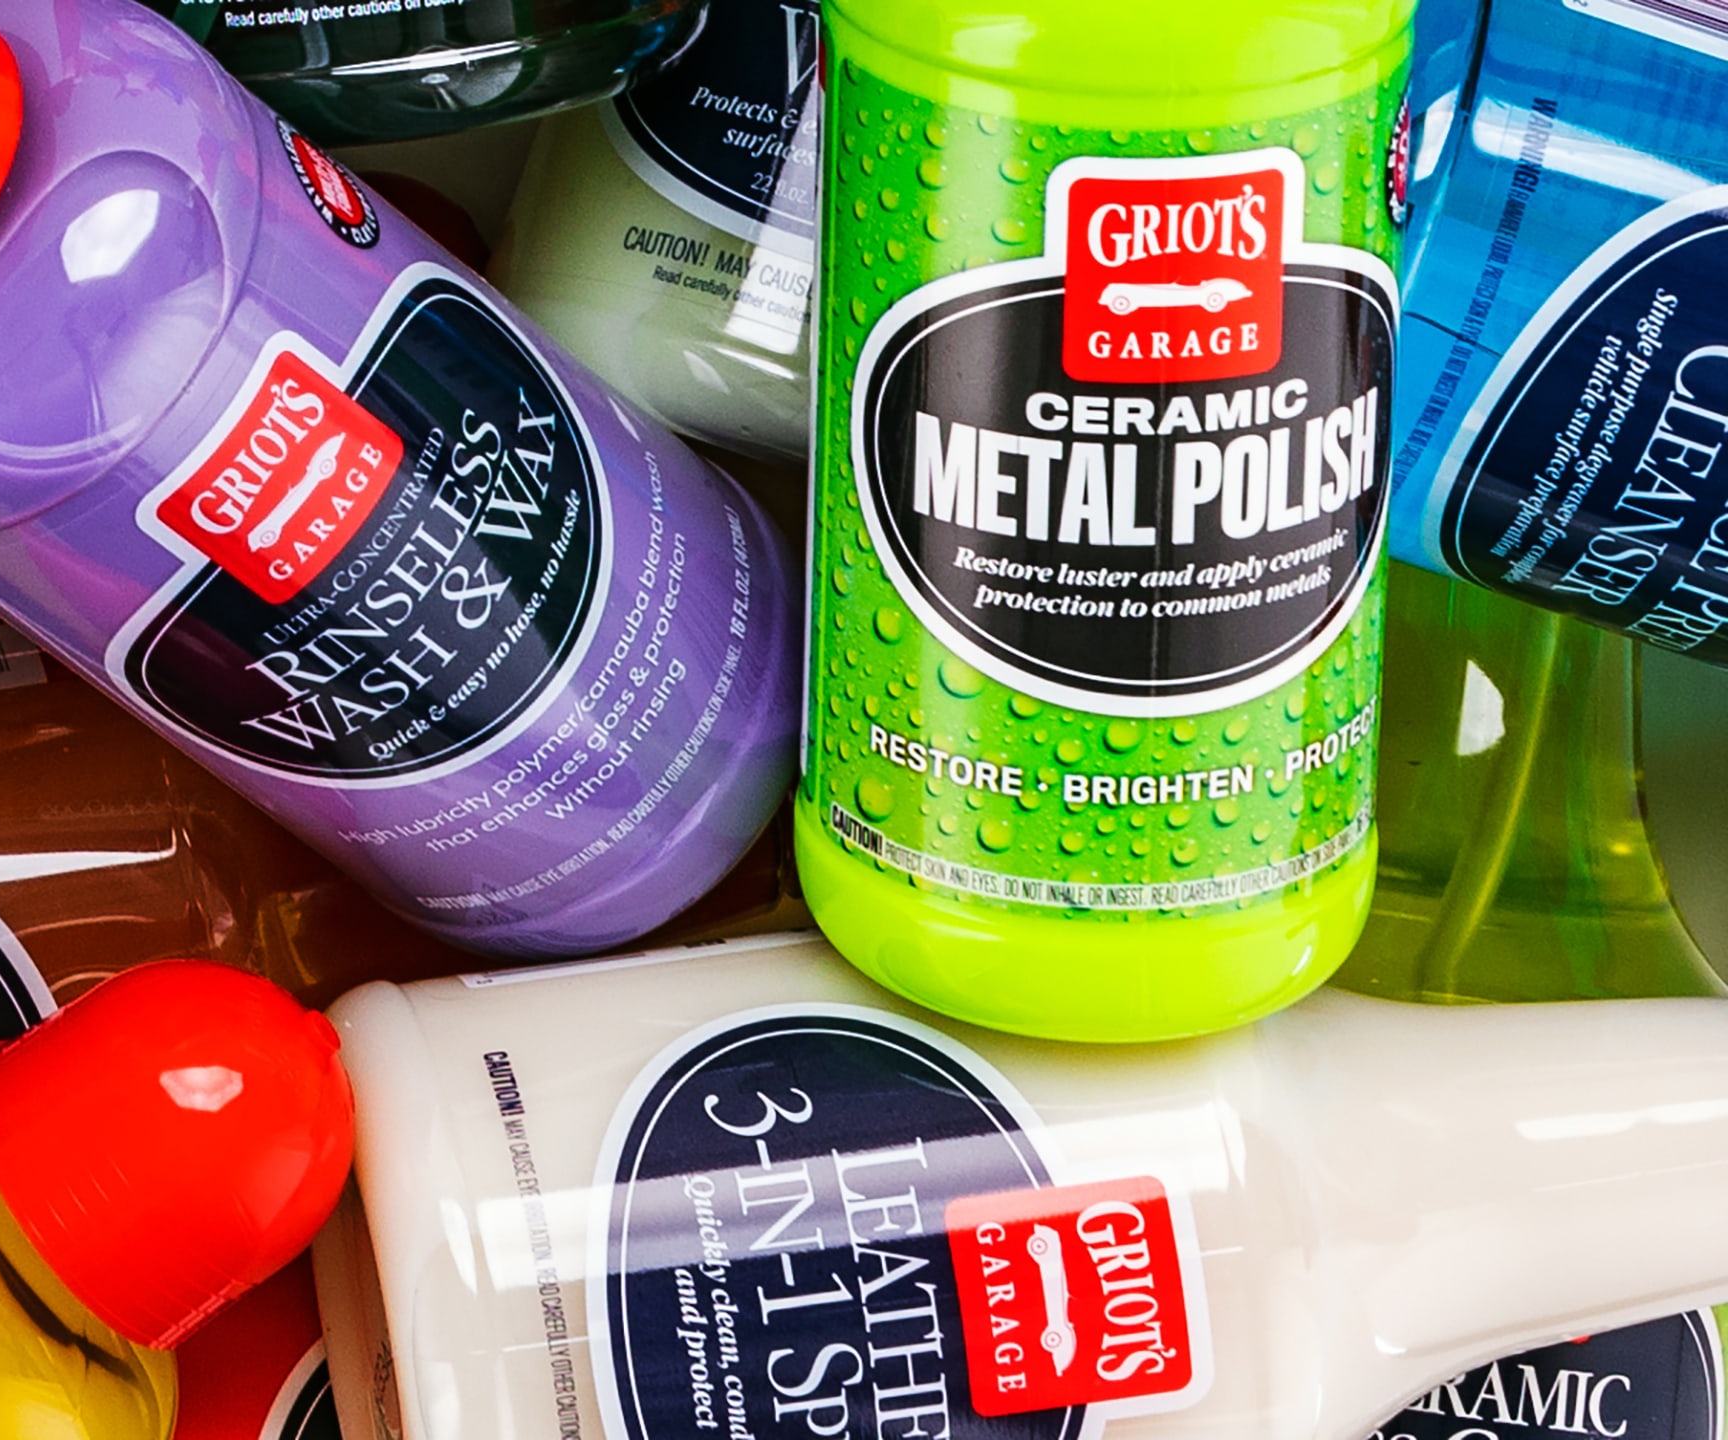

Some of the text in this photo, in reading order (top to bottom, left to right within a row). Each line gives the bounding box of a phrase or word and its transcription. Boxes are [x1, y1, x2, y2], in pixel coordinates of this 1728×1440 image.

[225, 1, 402, 27] Read carefully other cautions
[690, 86, 778, 124] Protects
[723, 128, 816, 166] surfaces
[750, 172, 774, 193] 22
[1513, 97, 1559, 194] WARNING!
[623, 227, 756, 279] CAUTION! MAY
[653, 266, 732, 301] Read carefully
[1087, 184, 1267, 267] GRIOT'S
[1025, 378, 1308, 436] CERAMIC
[1088, 323, 1259, 359] GARAGE
[1554, 288, 1679, 530] Single purpose degreaser
[1580, 334, 1622, 410] vehicle
[190, 379, 325, 534] GRIOT'S
[268, 443, 382, 581] GARAGE
[913, 387, 1379, 546] METAL POLISH
[1550, 344, 1728, 606] CLEANSER
[241, 387, 556, 751] WASH & WAX
[245, 408, 501, 701] RINSELESS
[264, 426, 444, 646] ULTRA-CONCENTRATED
[953, 527, 1350, 590] Restore luster and apply ceramic
[974, 565, 1331, 618] protection to common metals
[368, 487, 582, 761] Quick easy no hose, no hassle
[394, 451, 665, 838] lubricity polymer/carnauba blend wash
[426, 532, 686, 855] that enhances gloss & protection
[545, 657, 686, 821] Without rinsing
[870, 724, 1023, 797] RESTORE
[1063, 763, 1253, 805] BRIGHTEN
[831, 804, 884, 857] CAUTION!
[483, 1050, 575, 1394] CAUTION! OTHER
[683, 1174, 732, 1285] Quickly
[711, 1290, 741, 1370] clean,
[704, 1087, 854, 1325] 3-IN-1
[674, 1268, 719, 1430] and protect
[832, 1137, 952, 1440] LEATHE
[976, 1222, 1027, 1392] GARAGE
[1076, 1200, 1177, 1381] GRIOT'S
